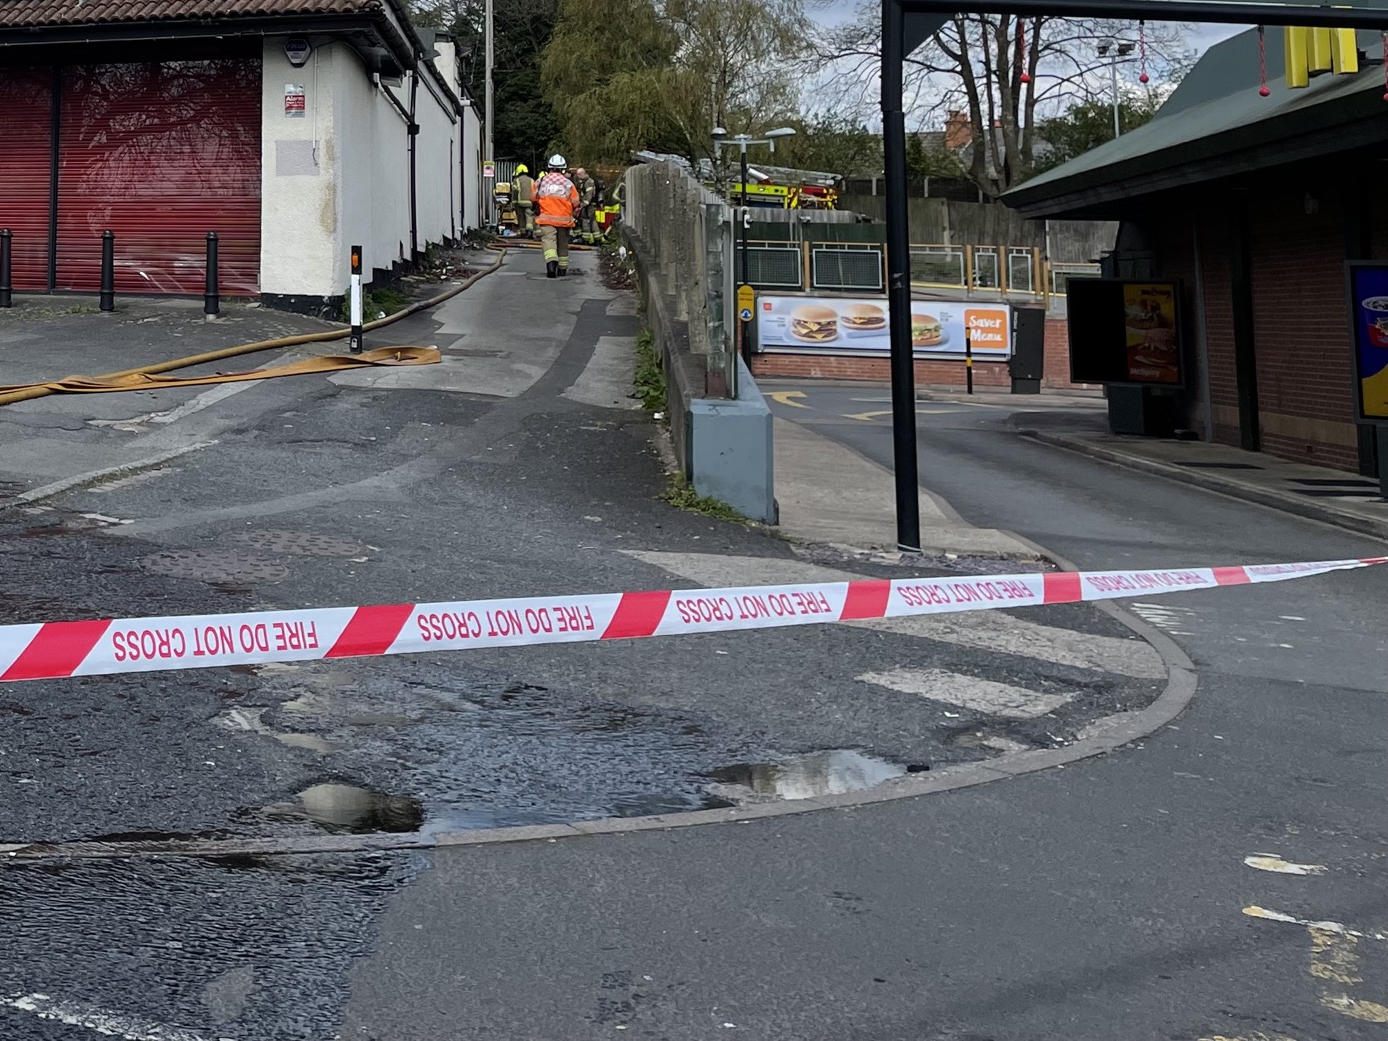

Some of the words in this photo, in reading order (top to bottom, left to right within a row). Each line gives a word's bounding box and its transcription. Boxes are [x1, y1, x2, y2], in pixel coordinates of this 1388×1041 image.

[969, 315, 1003, 328] Saver
[970, 329, 1003, 342] Menu
[897, 585, 951, 606] CROSS
[949, 583, 985, 602] NOT
[974, 582, 1005, 601] DO
[998, 579, 1035, 598] FIRE
[677, 598, 733, 623] CROSS
[734, 596, 770, 620] NOT
[769, 593, 797, 615] DO
[797, 593, 830, 613] FIRE
[418, 612, 481, 641] CROSS
[488, 610, 522, 637] NOT
[525, 608, 552, 633] DO
[554, 607, 594, 632] FIRE
[112, 629, 185, 661] CROSS
[194, 626, 234, 656] NOT
[239, 624, 269, 653] DO
[273, 623, 318, 649] FIRE
